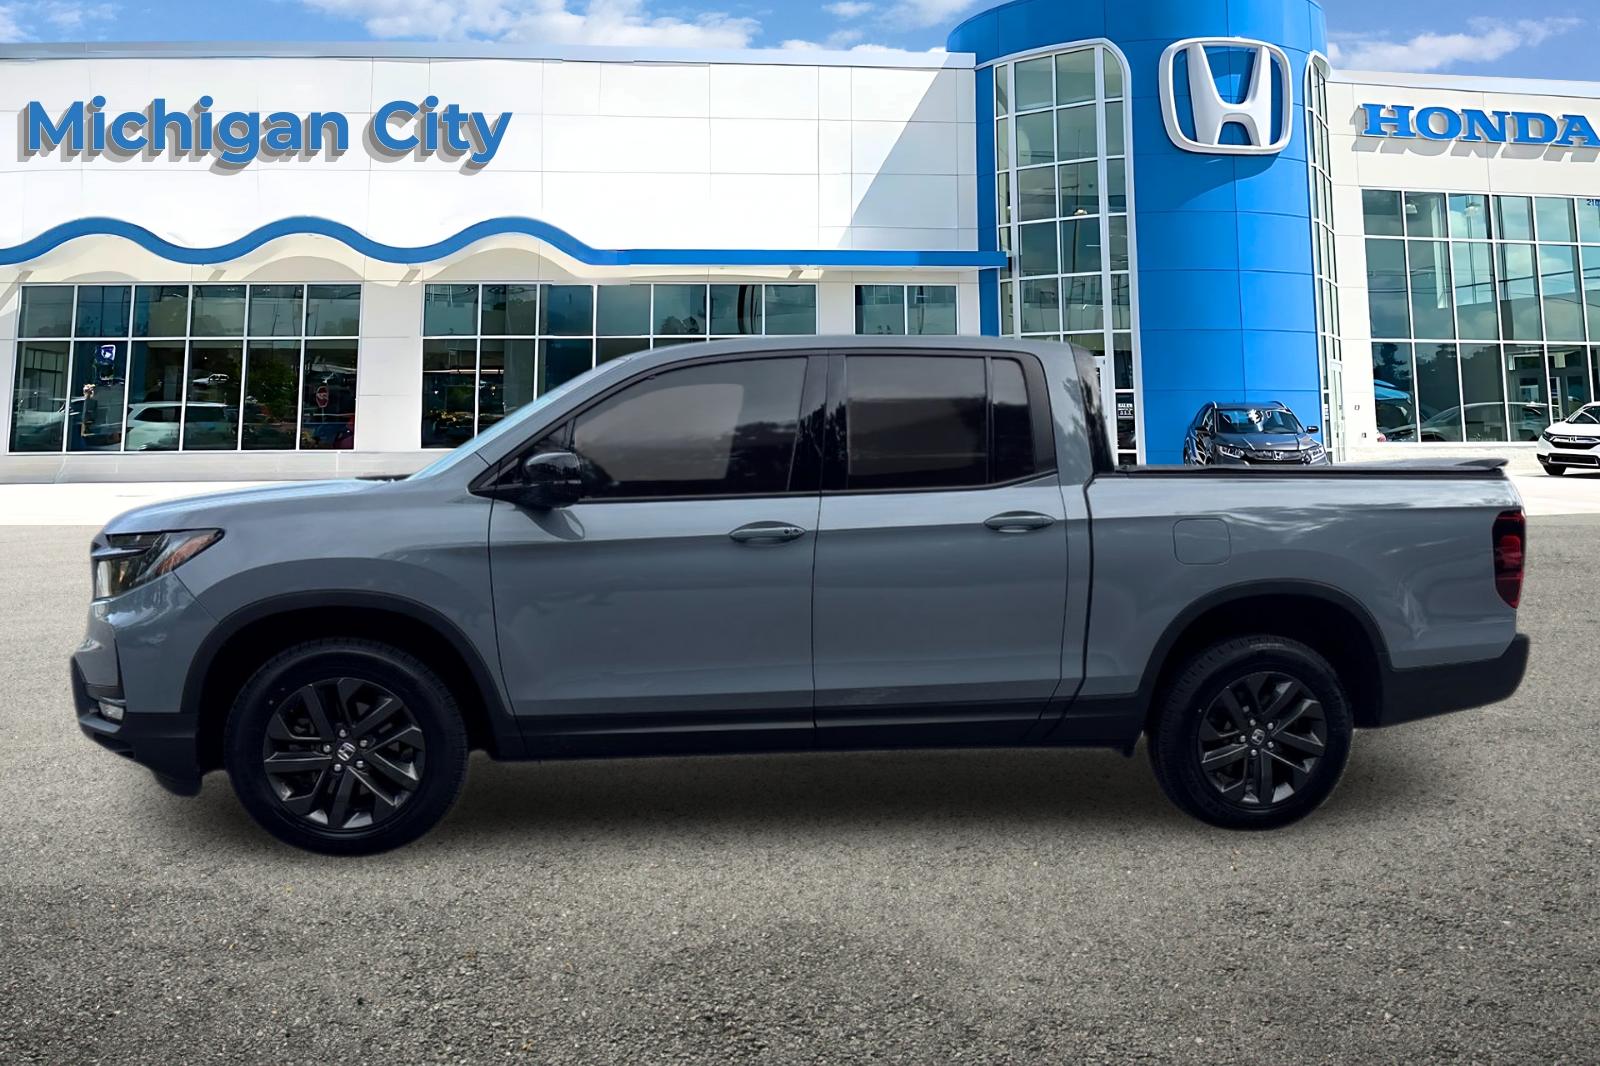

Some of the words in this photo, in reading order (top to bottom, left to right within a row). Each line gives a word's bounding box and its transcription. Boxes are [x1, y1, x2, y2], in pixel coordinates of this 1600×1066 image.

[27, 95, 350, 164] Michigan
[373, 95, 514, 163] City
[1361, 103, 1600, 147] HONDA
